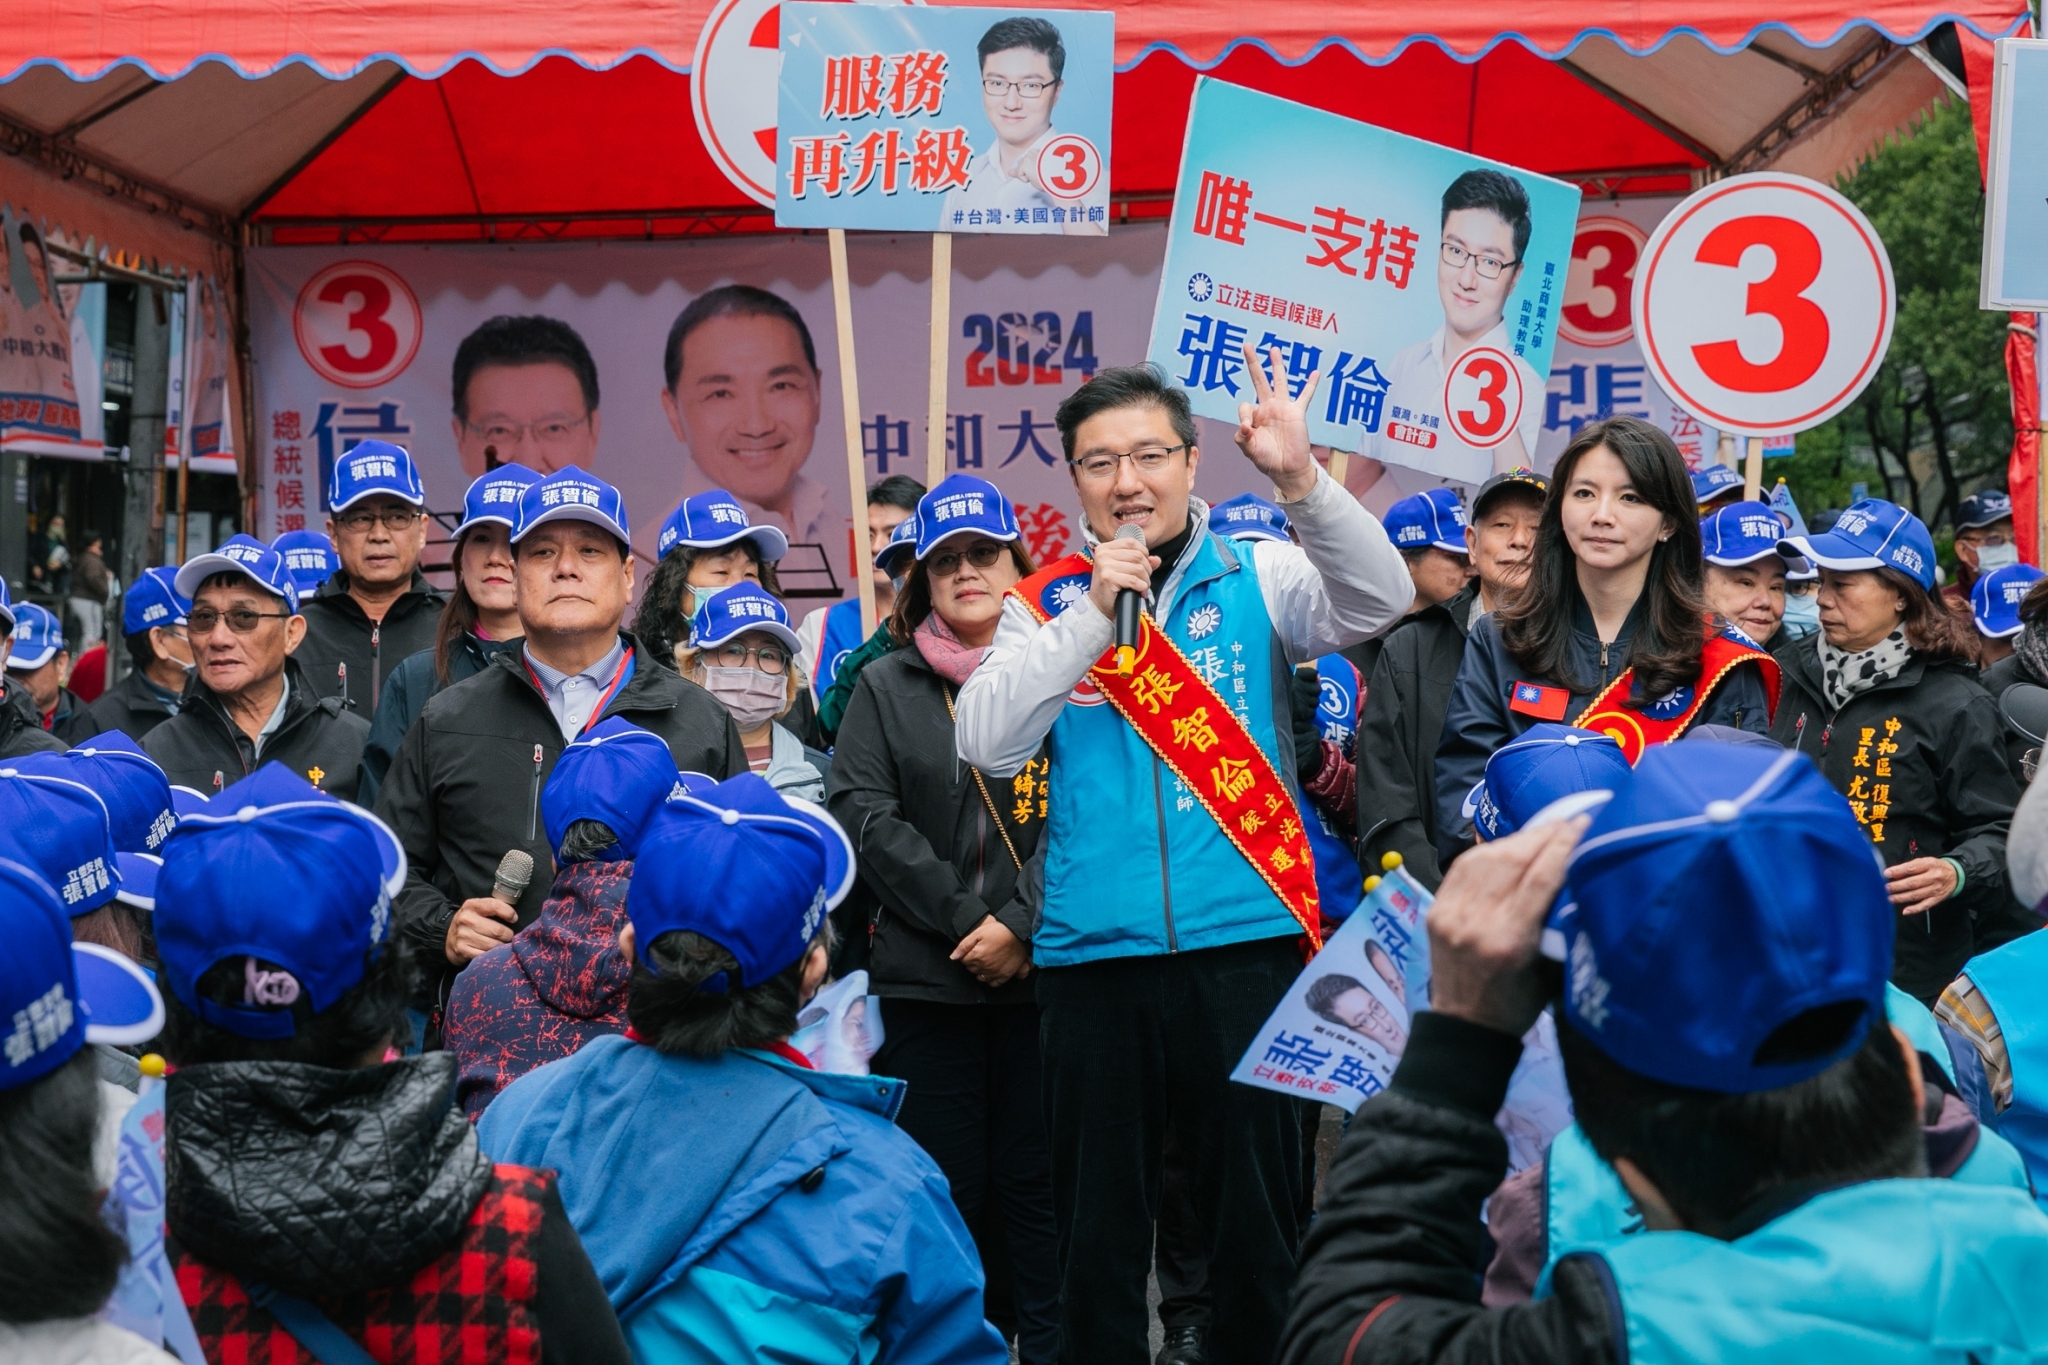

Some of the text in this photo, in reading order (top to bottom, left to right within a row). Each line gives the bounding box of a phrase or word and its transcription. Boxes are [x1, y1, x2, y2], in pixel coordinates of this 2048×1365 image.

[822, 52, 948, 118] 服務
[789, 130, 972, 197] 再升級
[1050, 144, 1087, 191] 3
[1193, 170, 1419, 289] 唯一支持
[1216, 283, 1339, 334] 立法委員候選人
[1531, 261, 1555, 350] 臺北商業大學
[1561, 229, 1637, 333] 3
[1691, 215, 1829, 393] 3
[319, 275, 398, 373] 3
[962, 311, 1099, 388] 2024
[1513, 299, 1533, 358] 助理教授
[1177, 312, 1392, 434] 張智倫
[1458, 357, 1510, 437] 3
[1394, 424, 1432, 447] 會計師
[351, 461, 397, 481] 張智倫
[541, 487, 600, 507] 張智倫
[934, 499, 984, 522] 張智倫
[728, 602, 777, 621] 張智倫
[1190, 645, 1230, 685] 張
[1321, 682, 1343, 714] 3
[1129, 662, 1256, 803] 張智倫
[308, 766, 325, 785] 中
[145, 815, 177, 849] 張智倫
[62, 867, 111, 904] 張智倫
